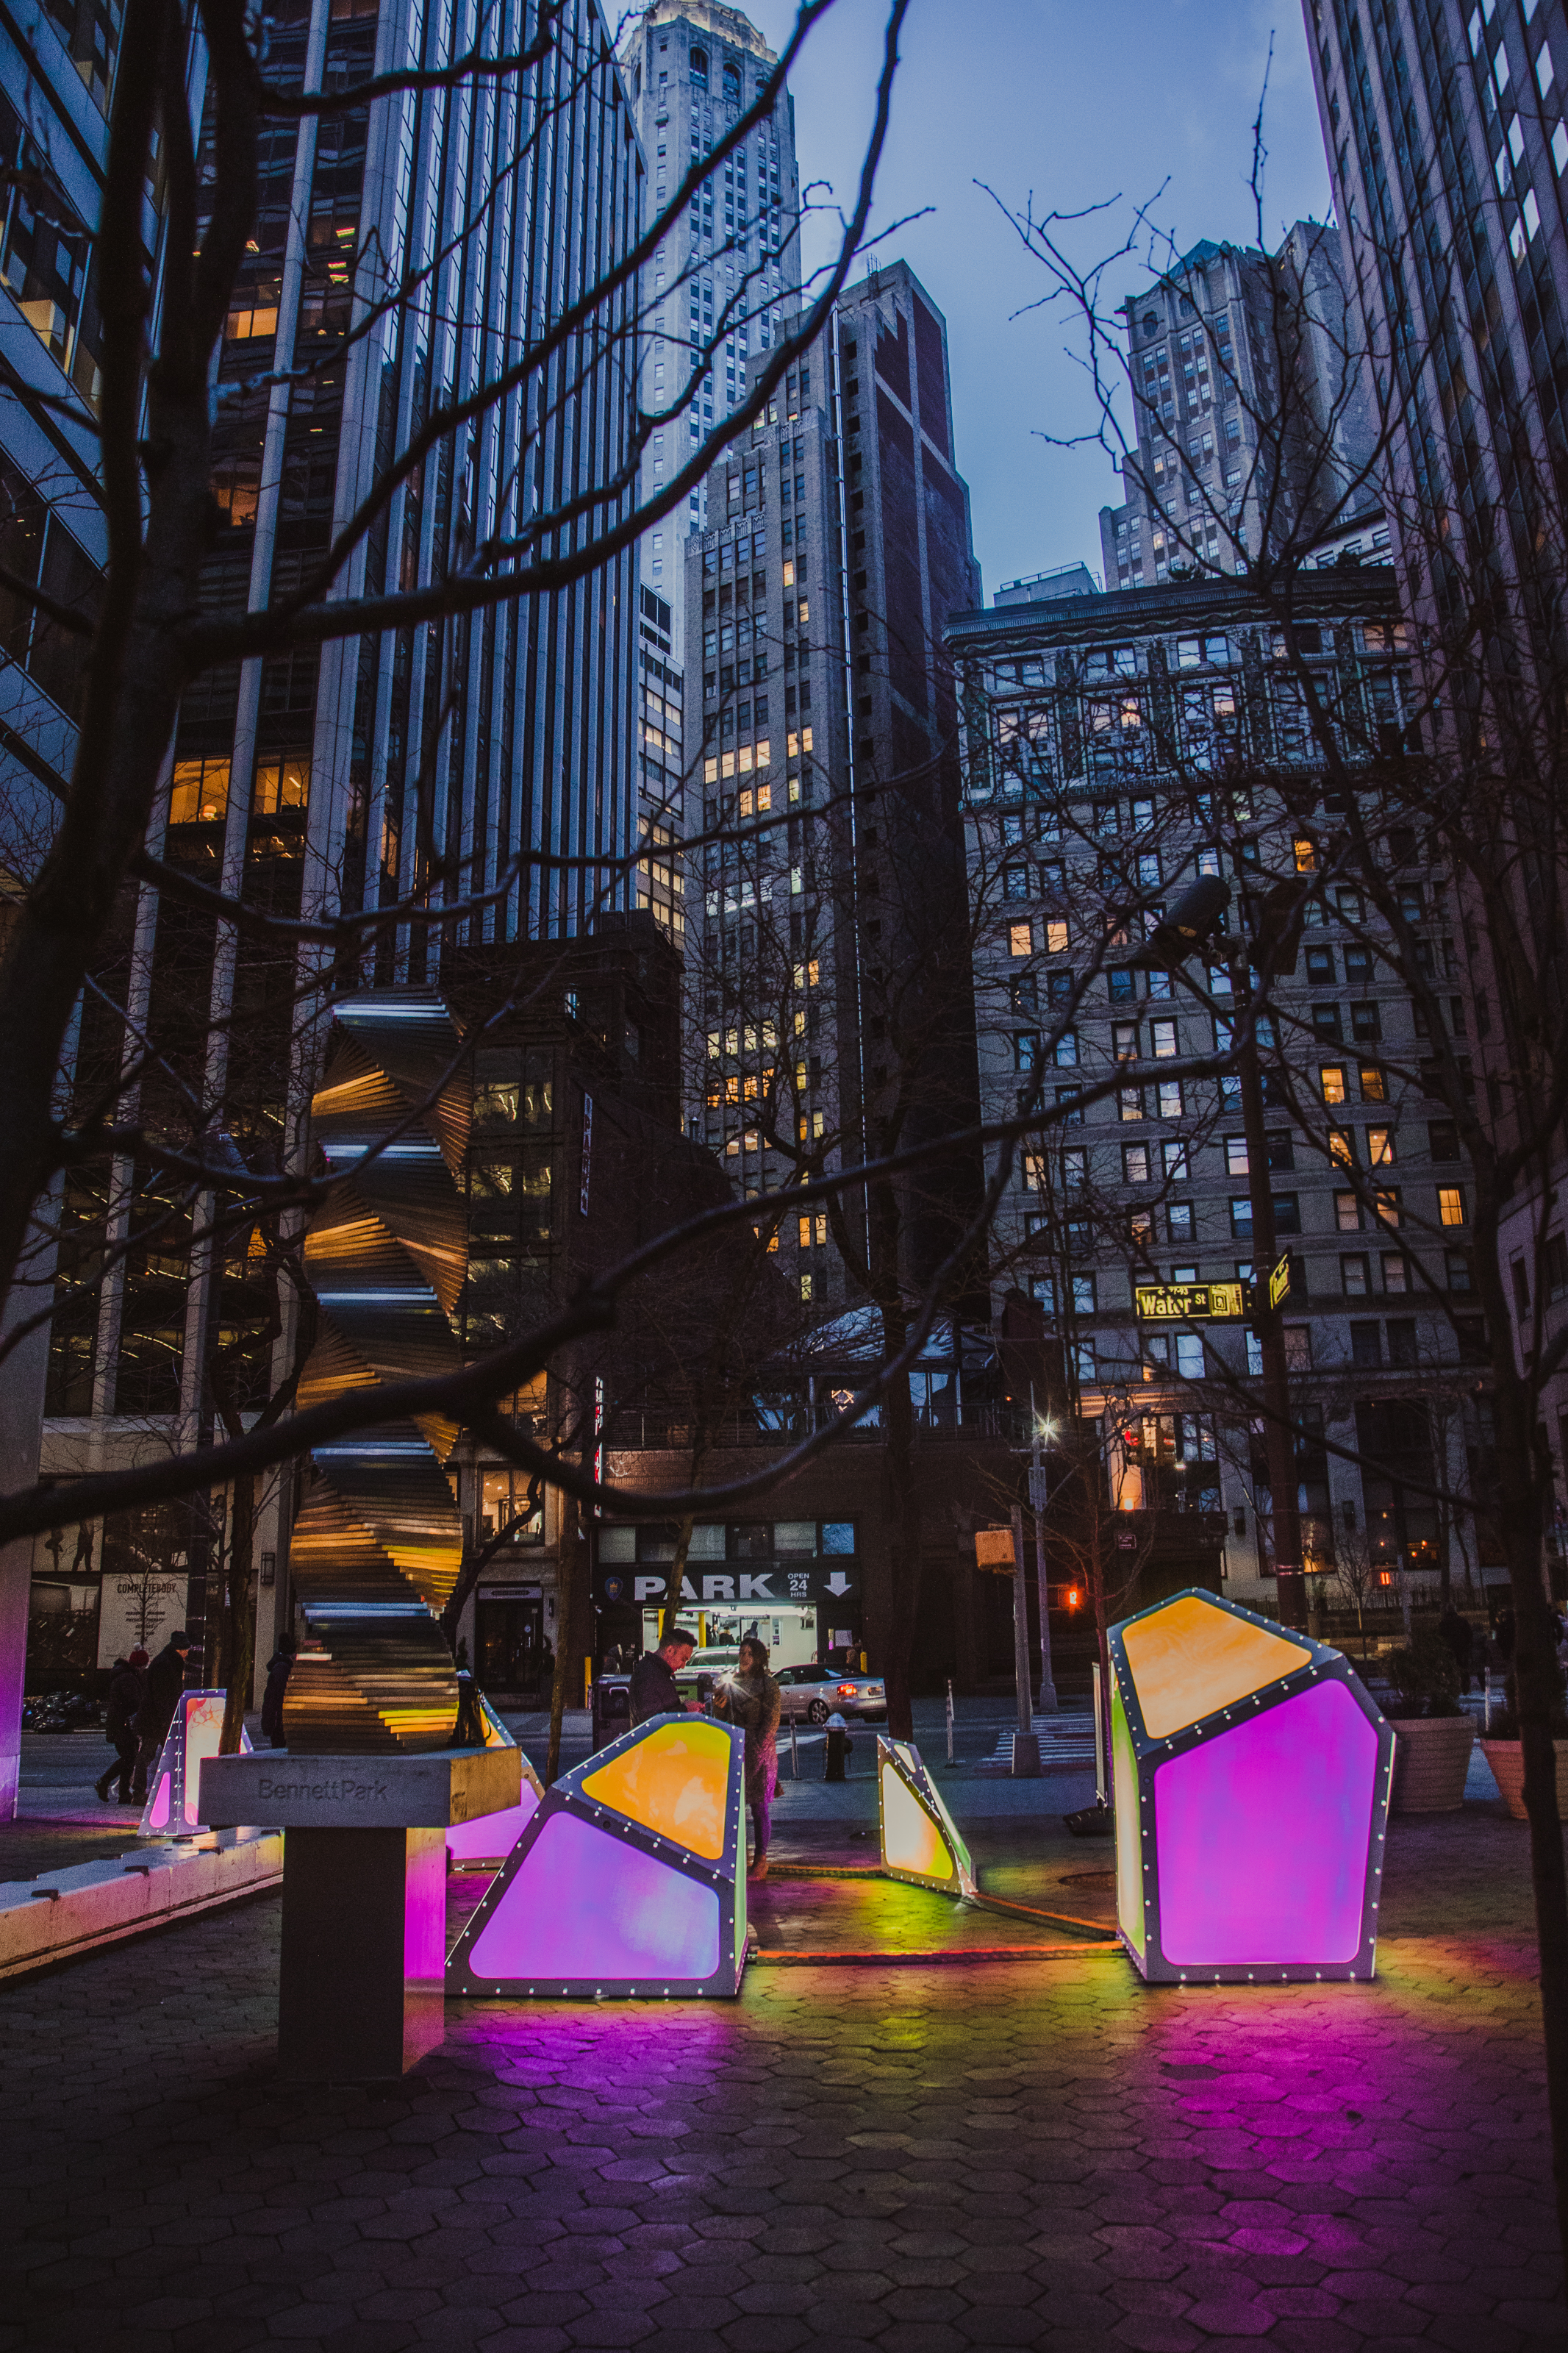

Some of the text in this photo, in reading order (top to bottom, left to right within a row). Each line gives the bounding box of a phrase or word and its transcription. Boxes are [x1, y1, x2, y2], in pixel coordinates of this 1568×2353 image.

[1195, 1293, 1206, 1305] St
[634, 1573, 776, 1601] PARK
[790, 1579, 808, 1591] 24
